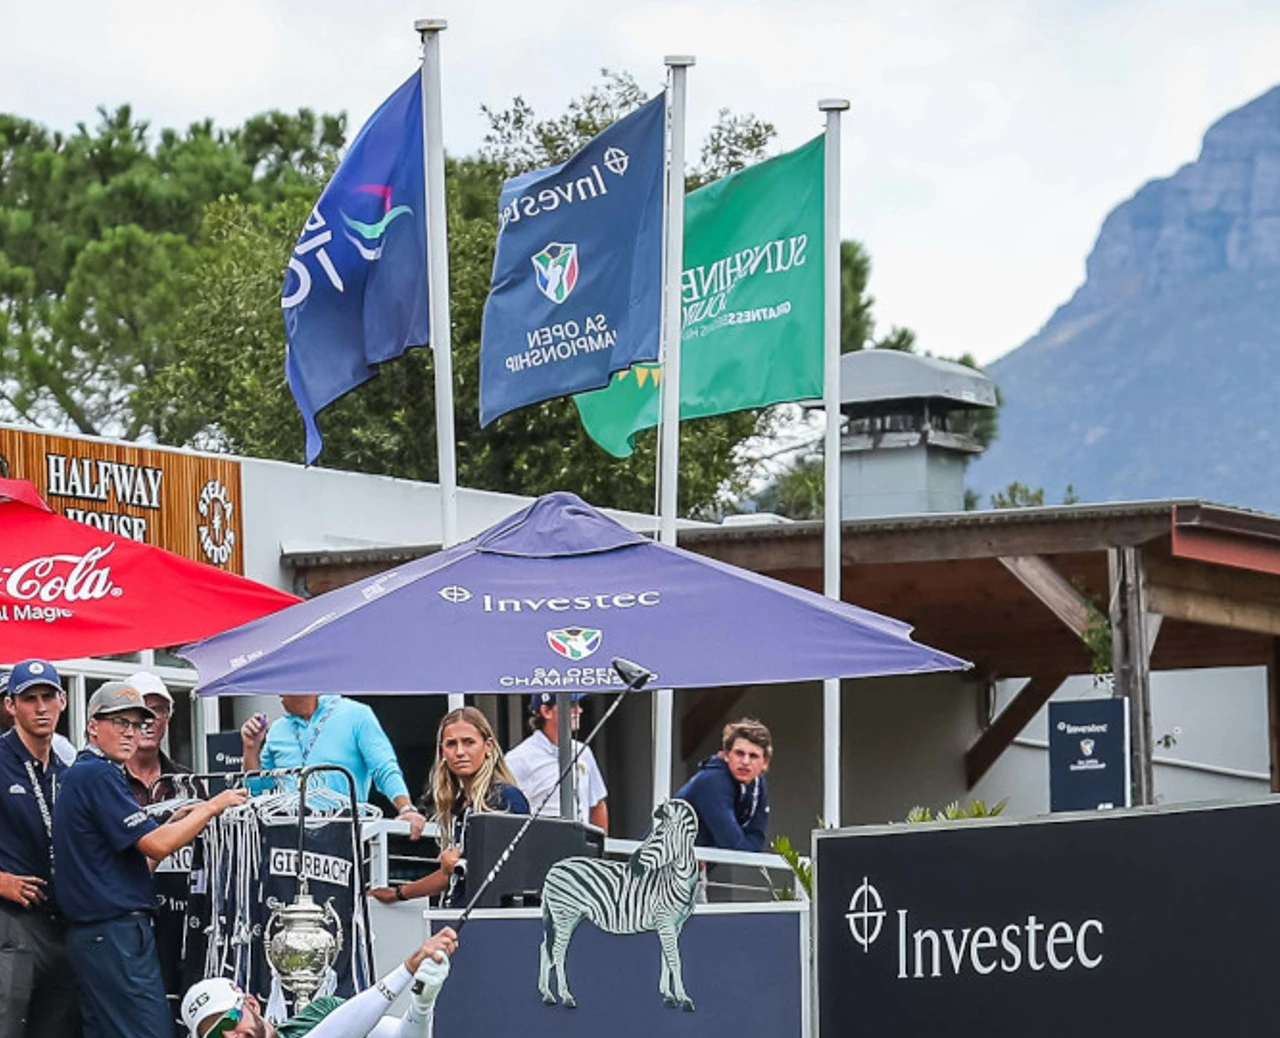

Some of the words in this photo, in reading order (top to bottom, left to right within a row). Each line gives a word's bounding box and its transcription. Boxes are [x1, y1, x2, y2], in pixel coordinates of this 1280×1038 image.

[46, 453, 163, 509] HALFWAY
[198, 479, 234, 519] STELLA
[483, 591, 661, 612] Investec
[499, 674, 659, 687] CHAMPIONSP
[533, 668, 561, 678] SA
[897, 909, 1104, 979] Investec
